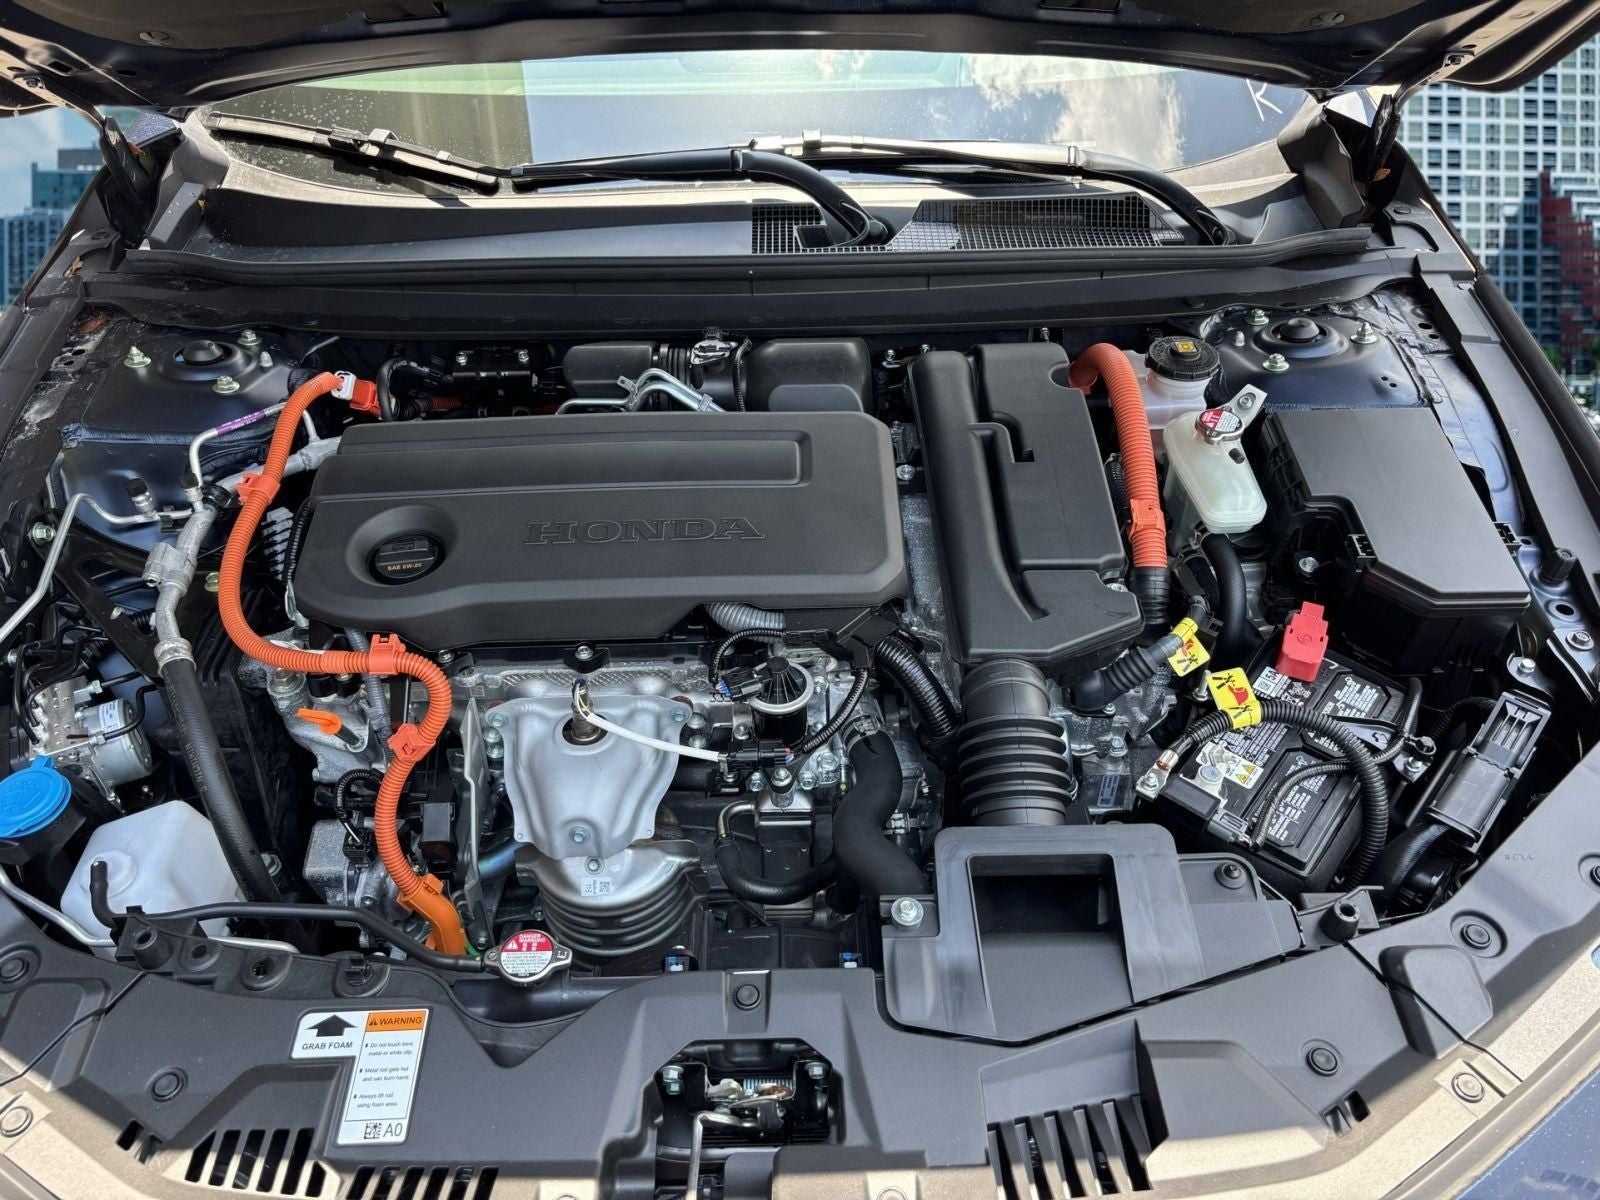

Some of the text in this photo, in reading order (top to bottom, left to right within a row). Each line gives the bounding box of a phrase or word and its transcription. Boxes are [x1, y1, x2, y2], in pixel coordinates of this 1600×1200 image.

[524, 517, 765, 545] HONDA
[379, 1016, 423, 1026] WARNING
[302, 1041, 353, 1050] GRAB FOAM
[382, 1122, 403, 1138] A0
